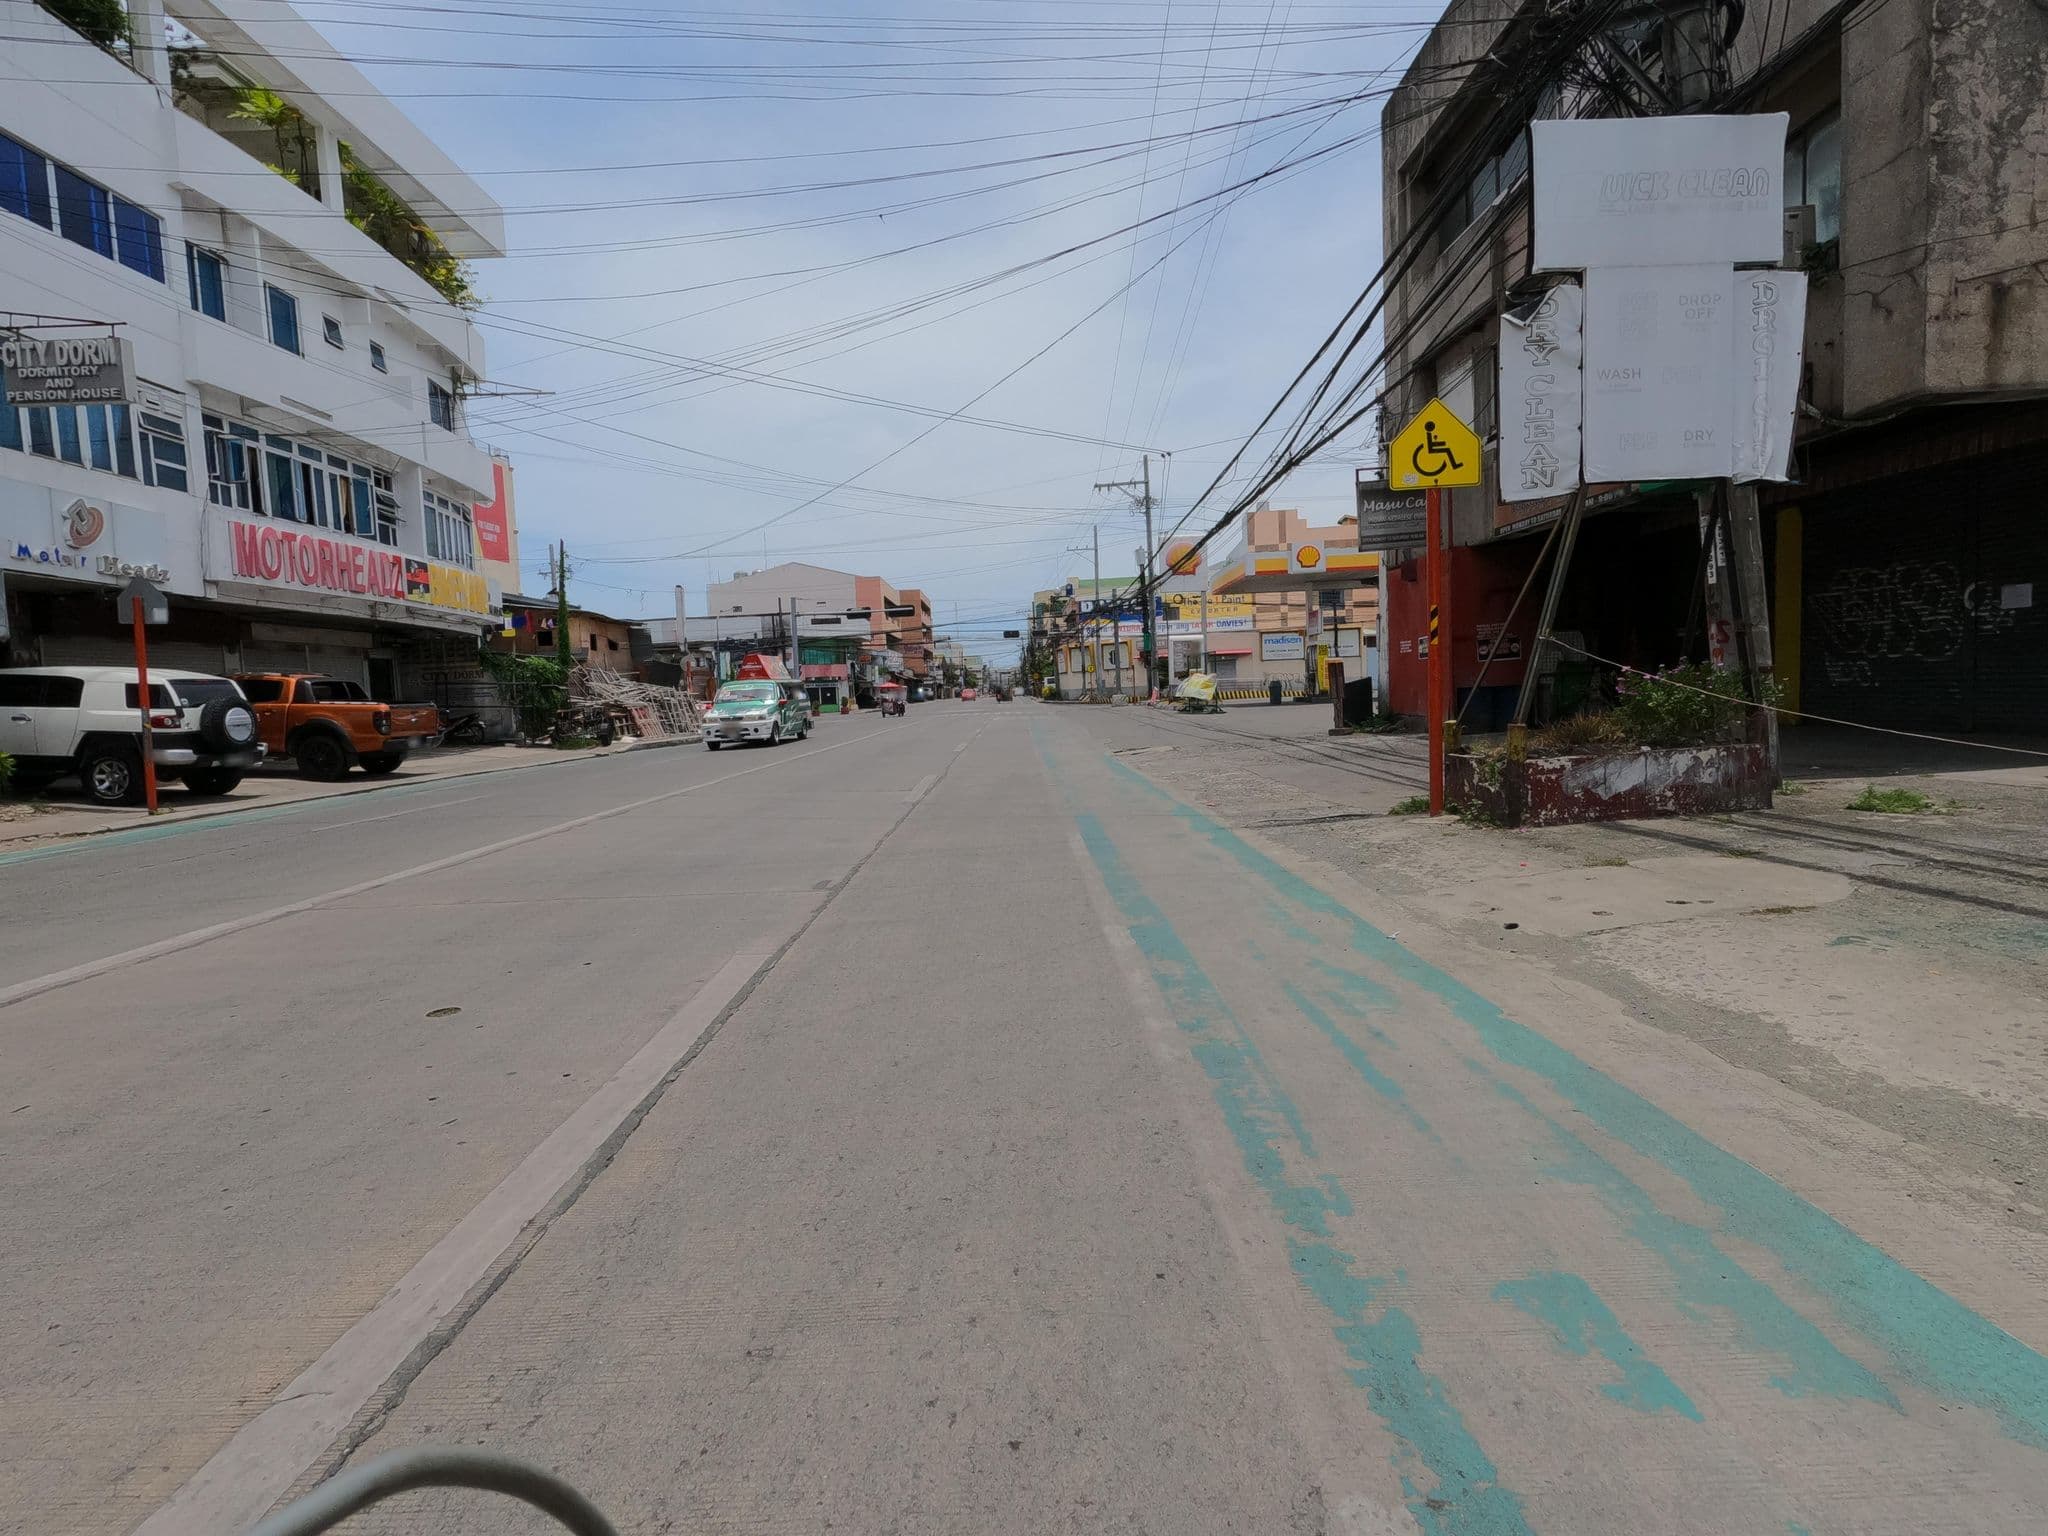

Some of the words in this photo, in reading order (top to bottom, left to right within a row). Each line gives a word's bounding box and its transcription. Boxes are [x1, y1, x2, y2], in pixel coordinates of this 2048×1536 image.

[1679, 167, 1769, 201] CLEAN
[1679, 293, 1722, 306] DROP
[1684, 307, 1715, 320] OFF
[1523, 297, 1560, 367] DRY
[2, 341, 47, 368] CITY
[54, 339, 117, 366] DORM
[17, 365, 98, 378] DORMITORY
[1596, 367, 1642, 380] WASH
[44, 377, 73, 388] AND
[6, 389, 67, 401] PENSION
[71, 387, 122, 399] HOUSE
[1520, 374, 1560, 490] CLEAN
[1683, 429, 1715, 441] DRY
[1363, 499, 1404, 512] Masu
[1406, 496, 1427, 509] Ca
[14, 541, 88, 568] Motor
[97, 555, 171, 581] Headz
[229, 521, 405, 600] MOTORHEADZ
